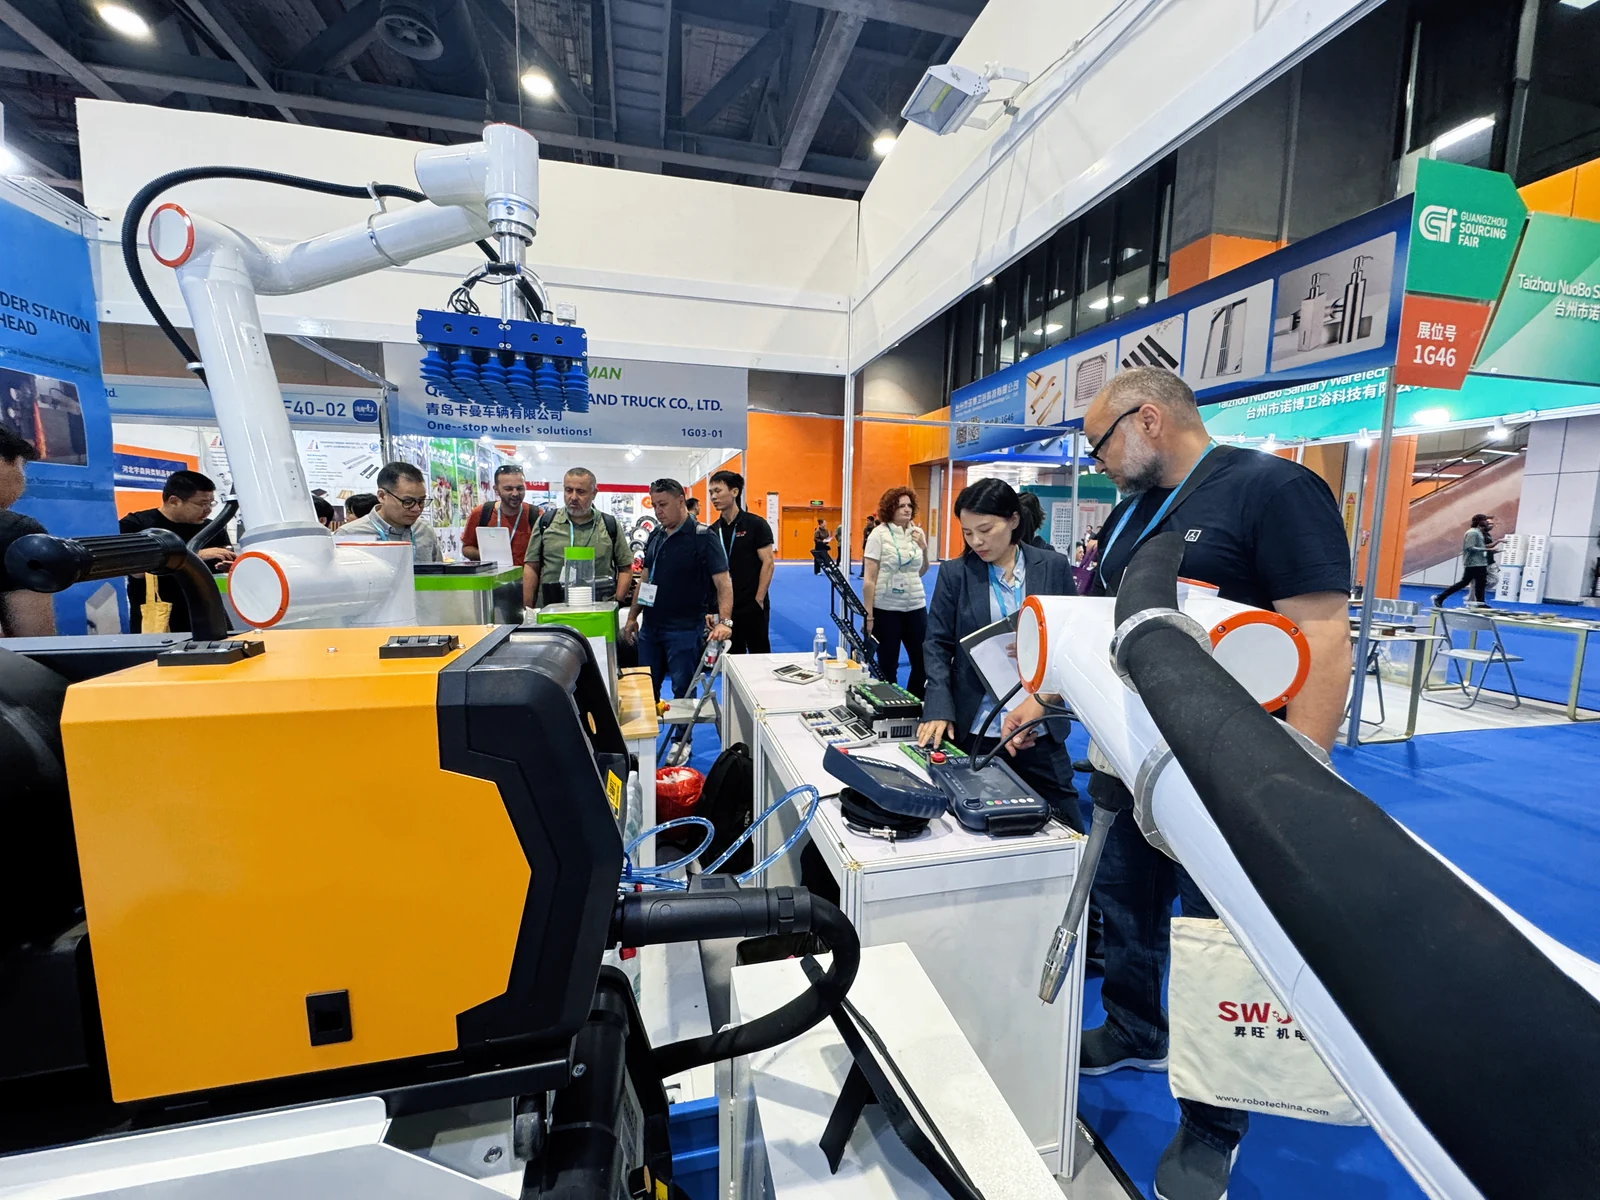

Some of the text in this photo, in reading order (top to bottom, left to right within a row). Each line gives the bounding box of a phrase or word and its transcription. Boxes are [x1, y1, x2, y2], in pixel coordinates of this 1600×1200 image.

[1461, 211, 1507, 227] GUANGZHOU
[1460, 222, 1506, 239] SOURCING
[1458, 234, 1479, 247] FAIR
[1518, 274, 1600, 299] Taizhou NuoBo S
[32, 303, 91, 333] STATION
[1555, 300, 1600, 321] 台州市诺
[1417, 321, 1456, 342] 展位号
[1413, 345, 1456, 367] 1G46
[104, 387, 118, 397] td.
[426, 402, 562, 421] 青岛卡曼车辆有限公司
[621, 395, 666, 408] TRUCK
[669, 398, 694, 411] CO.,
[697, 399, 723, 411] LTD.
[490, 425, 534, 434] wheels'
[537, 426, 592, 436] solutions!
[681, 428, 723, 438] 1G03-01
[1215, 1094, 1330, 1116] www.robotechina.com
